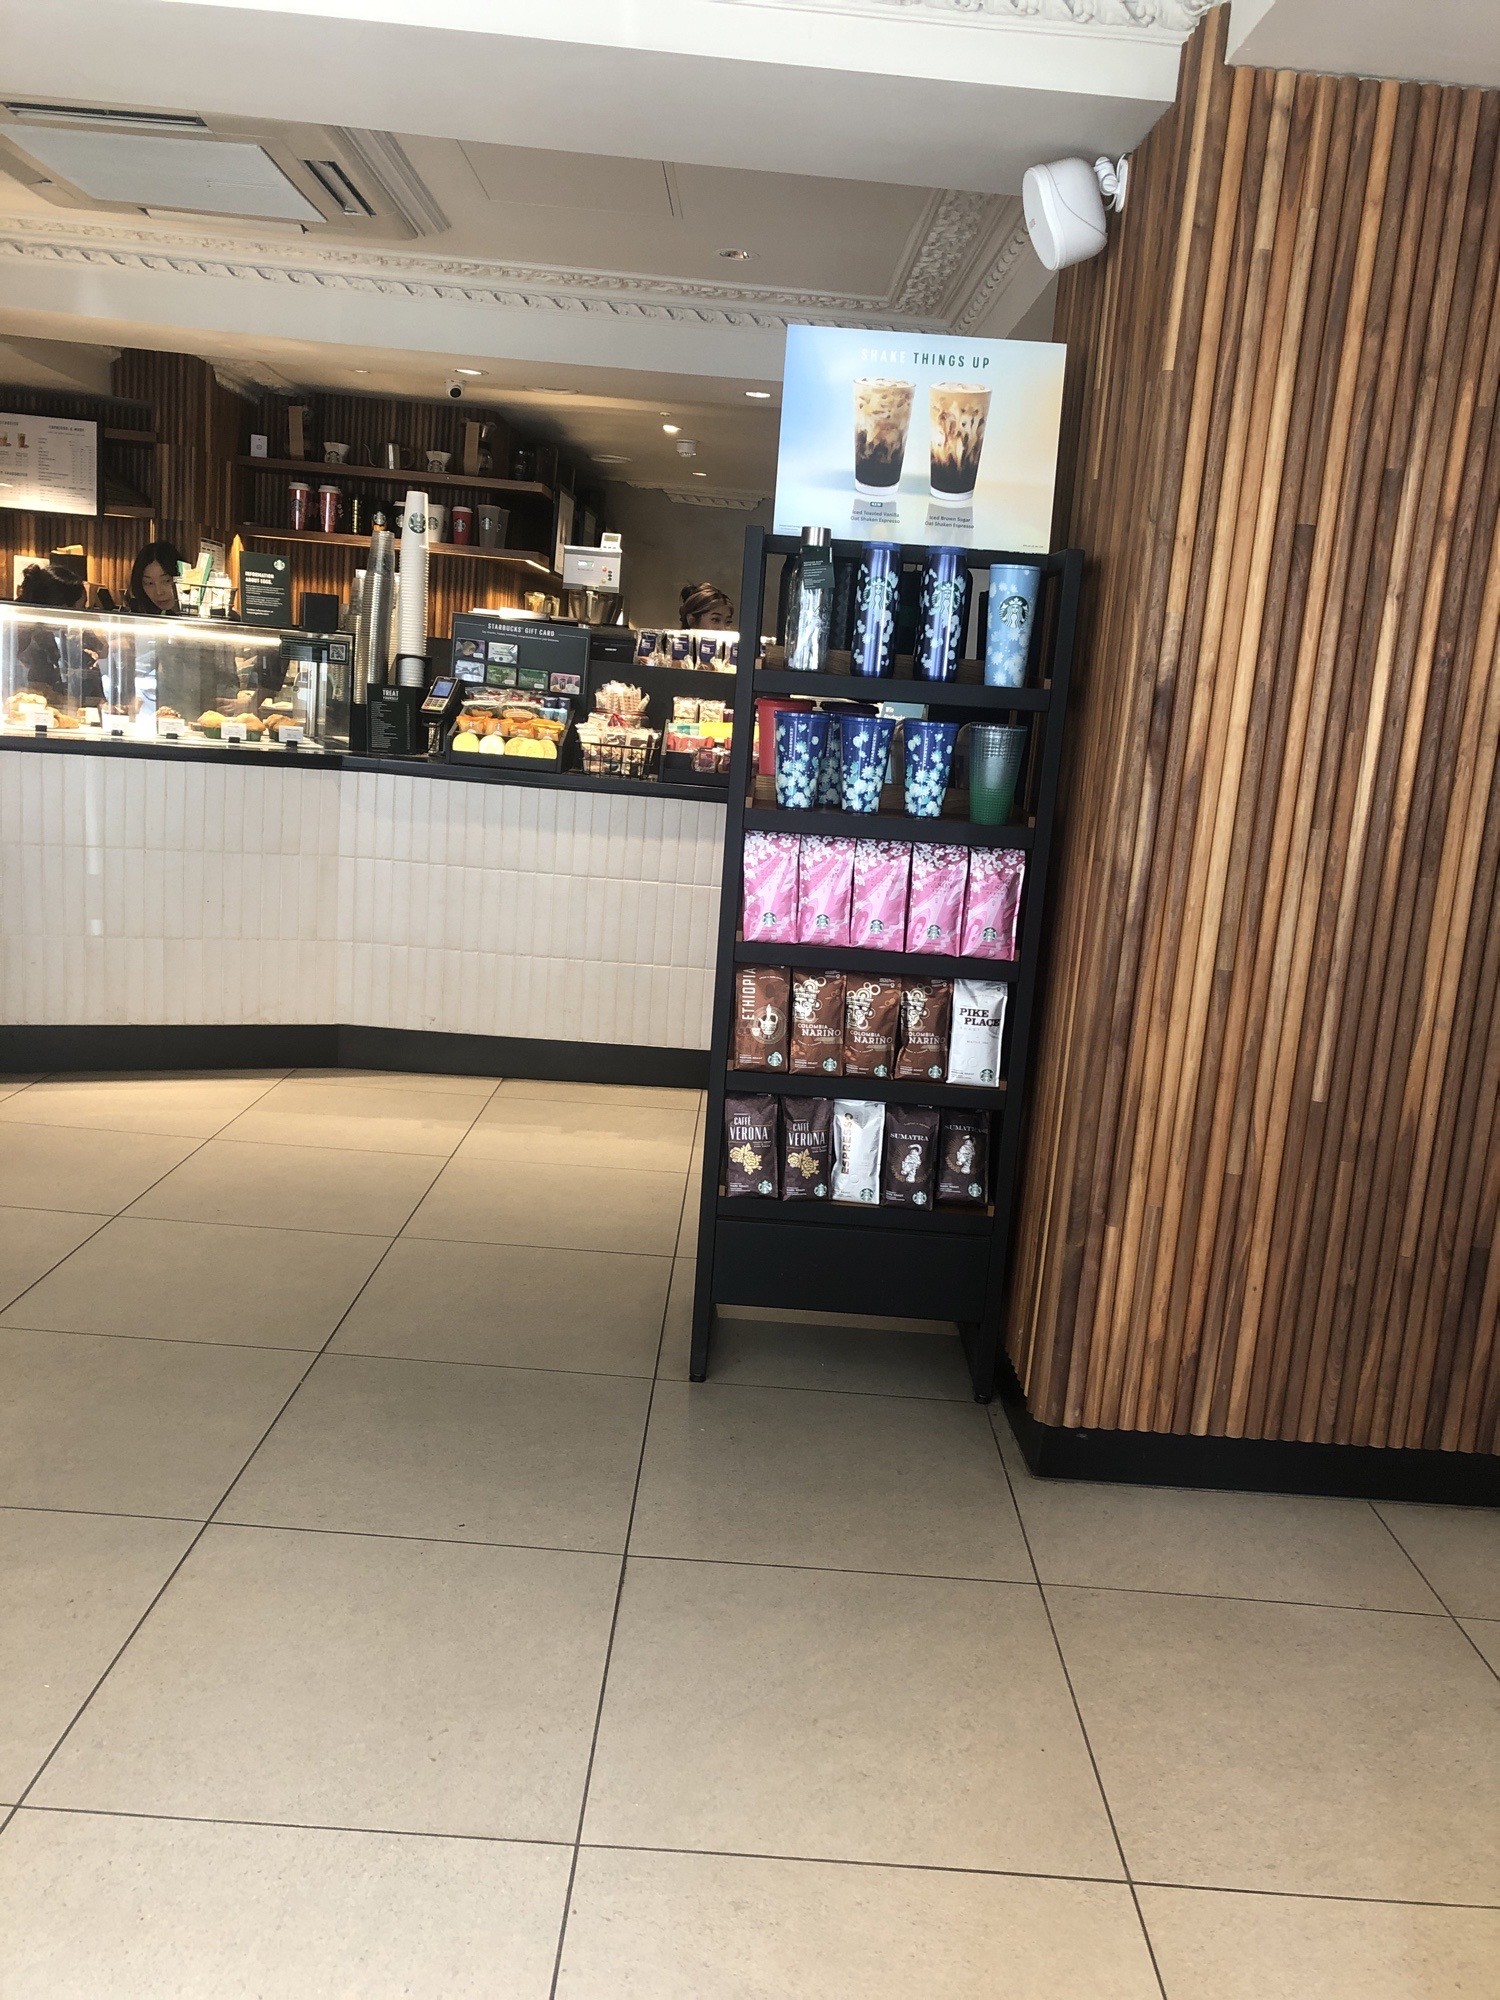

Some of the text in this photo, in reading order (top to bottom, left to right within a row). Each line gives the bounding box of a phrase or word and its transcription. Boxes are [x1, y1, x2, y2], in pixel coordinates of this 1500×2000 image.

[860, 348, 990, 369] SHAKE THINGS UP
[524, 627, 538, 636] GIFT
[539, 629, 555, 637] CARD
[382, 689, 399, 697] TREAT
[742, 967, 756, 1020] ETHIOPIA
[959, 1007, 989, 1018] PIKE
[964, 1017, 1001, 1027] PLACE
[801, 1027, 841, 1037] NARIÑO
[854, 1035, 893, 1045] NARIÑO
[909, 1035, 946, 1045] NARIÑO
[729, 1126, 768, 1141] VERONA
[890, 1132, 929, 1142] SUMATRA
[788, 1132, 826, 1147] VERONA
[841, 1112, 854, 1175] ESPRESSO
